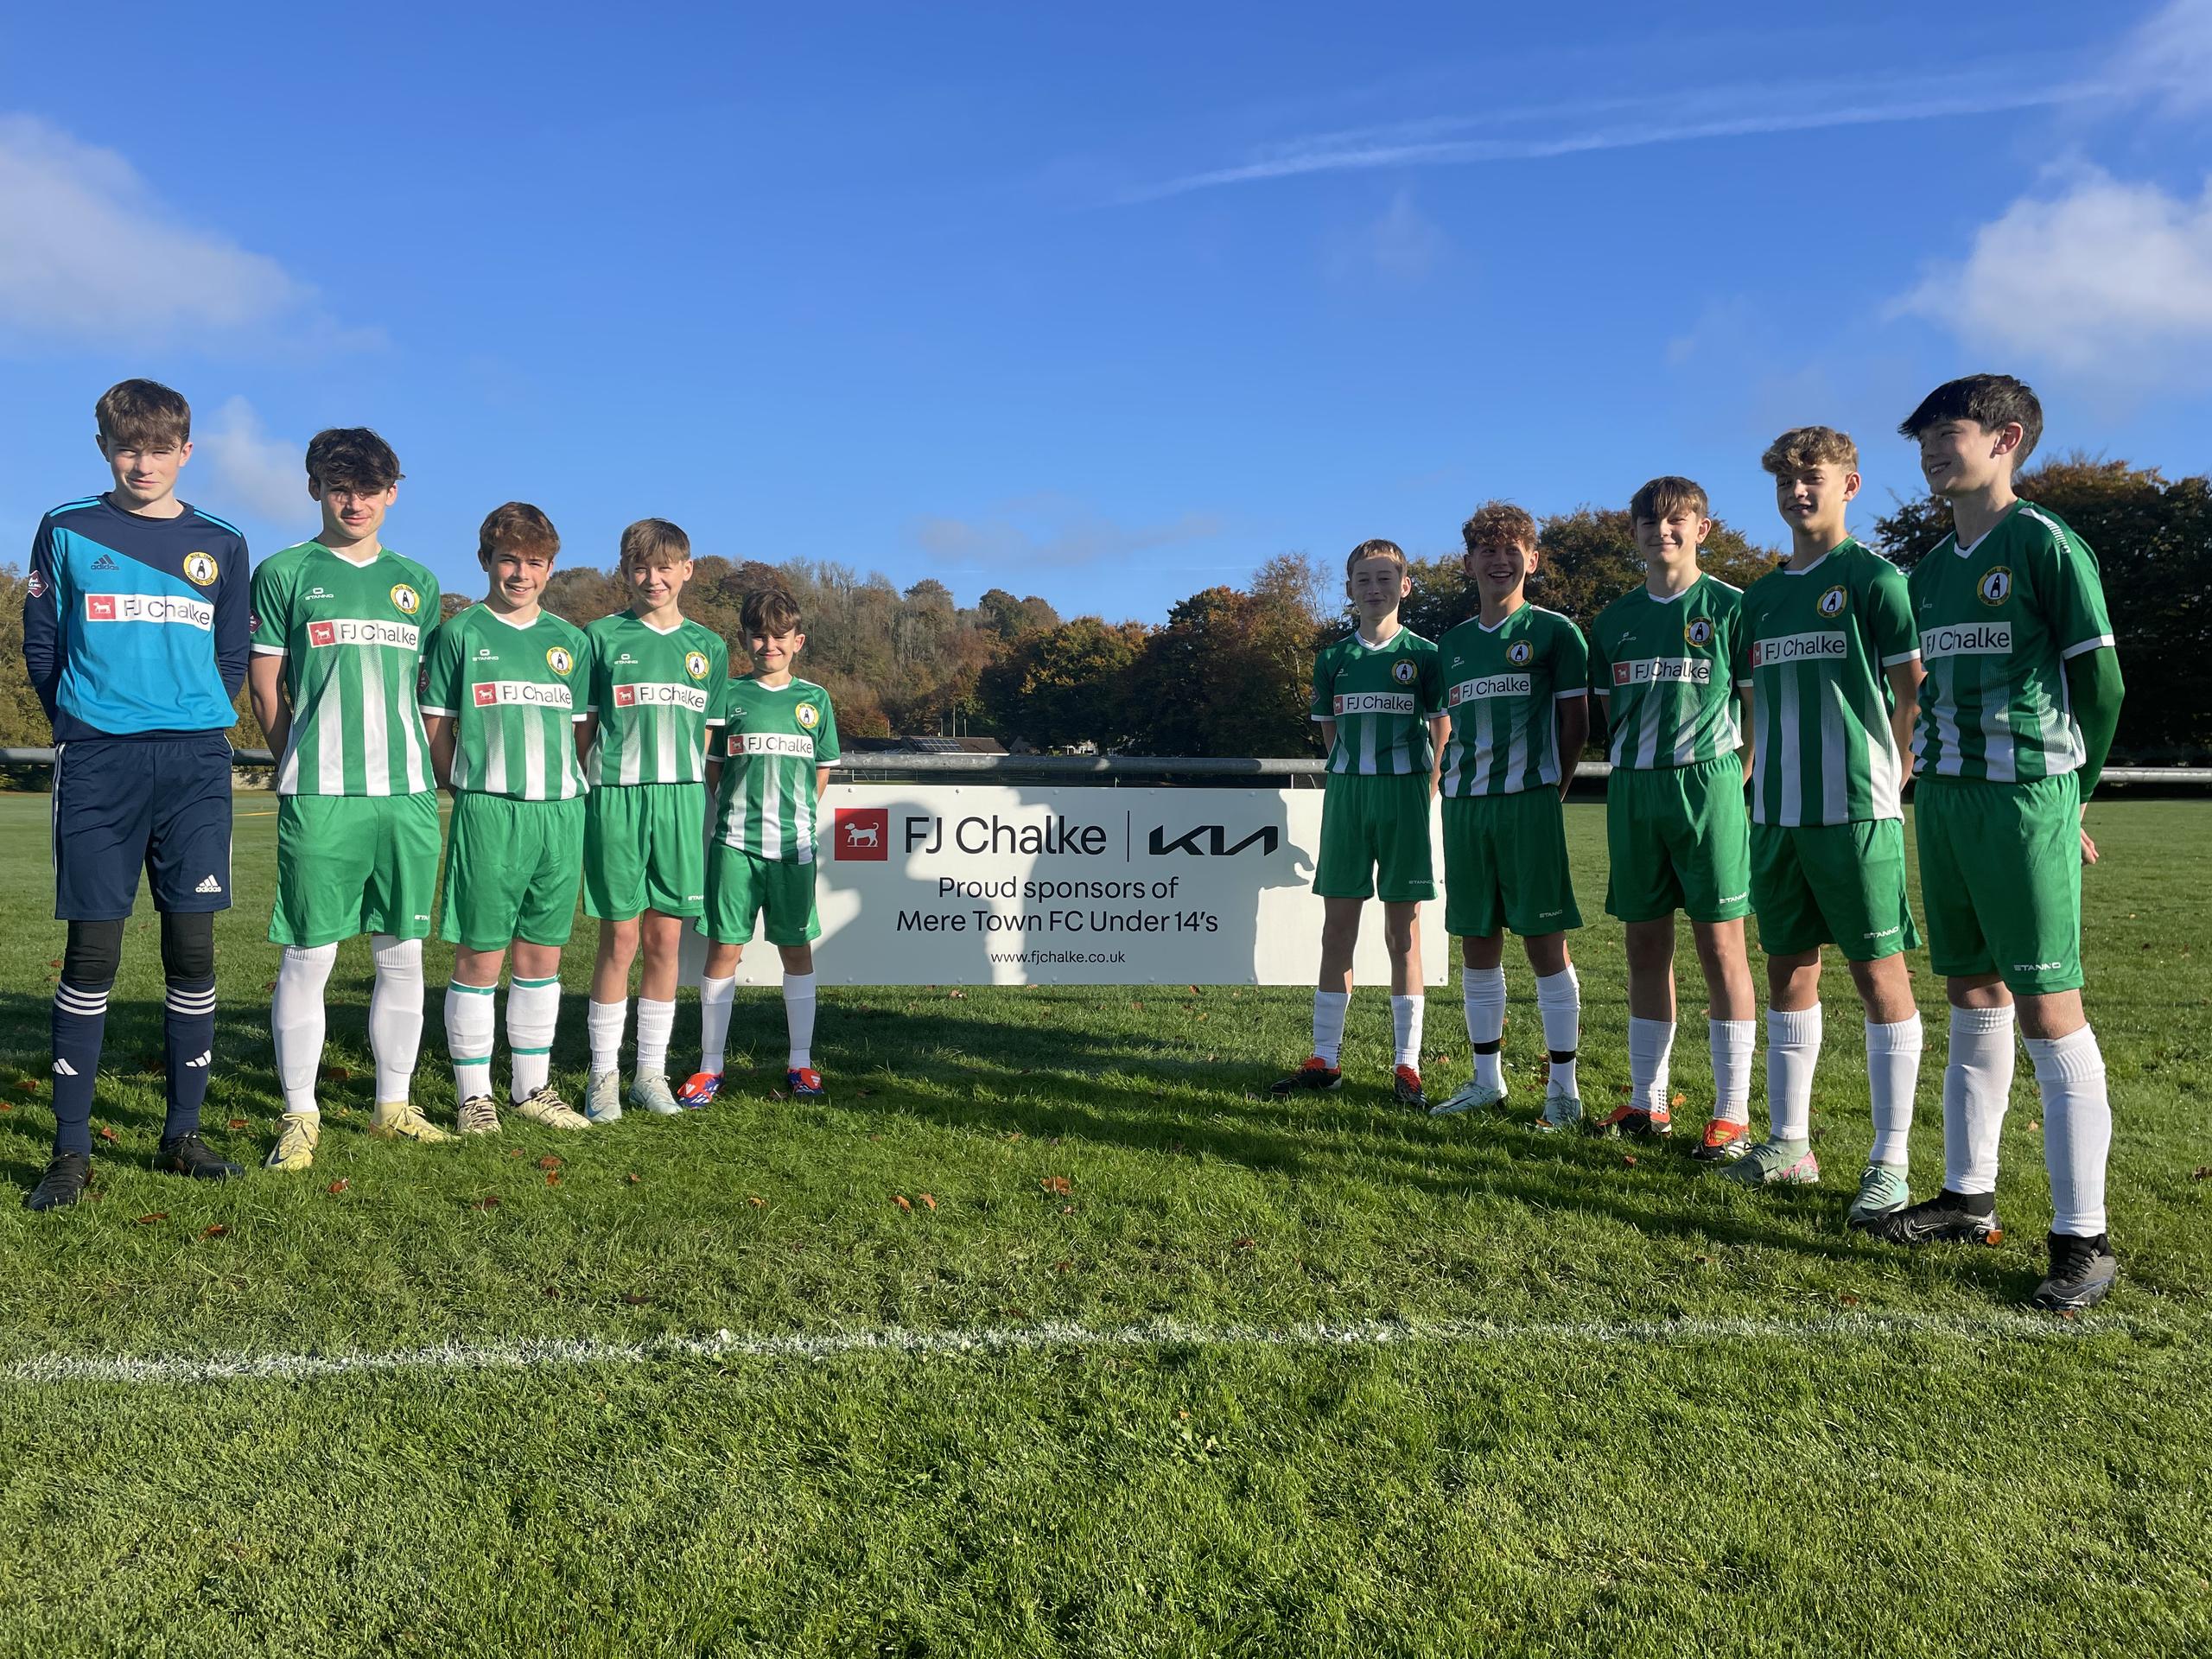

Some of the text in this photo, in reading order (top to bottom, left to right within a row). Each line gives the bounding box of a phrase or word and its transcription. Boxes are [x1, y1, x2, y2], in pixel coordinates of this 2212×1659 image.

[124, 594, 210, 626] FJ Chalke
[340, 624, 416, 645] FJ Chalke
[1927, 627, 2010, 654] FJ Chalke
[1765, 635, 1846, 659] FJ Chalke
[1636, 661, 1709, 679] FJ Chalke
[503, 686, 571, 704] FJ Chalke
[639, 685, 705, 709] FJ Chalke
[1462, 677, 1529, 698] FJ Chalke
[1347, 696, 1413, 710] FJ Chalke
[748, 736, 812, 754] FJ Chalke
[905, 815, 1107, 855] FJ Chalke
[1149, 825, 1278, 856] KIA
[195, 884, 221, 893] adidas
[939, 876, 1179, 903] Proud sponsors of
[897, 910, 1218, 932] Mere Town FC Under 14's
[1864, 926, 1899, 938] STANNO
[991, 950, 1125, 964] www.fjchalke.co.uk
[2014, 962, 2062, 971] STANNO
